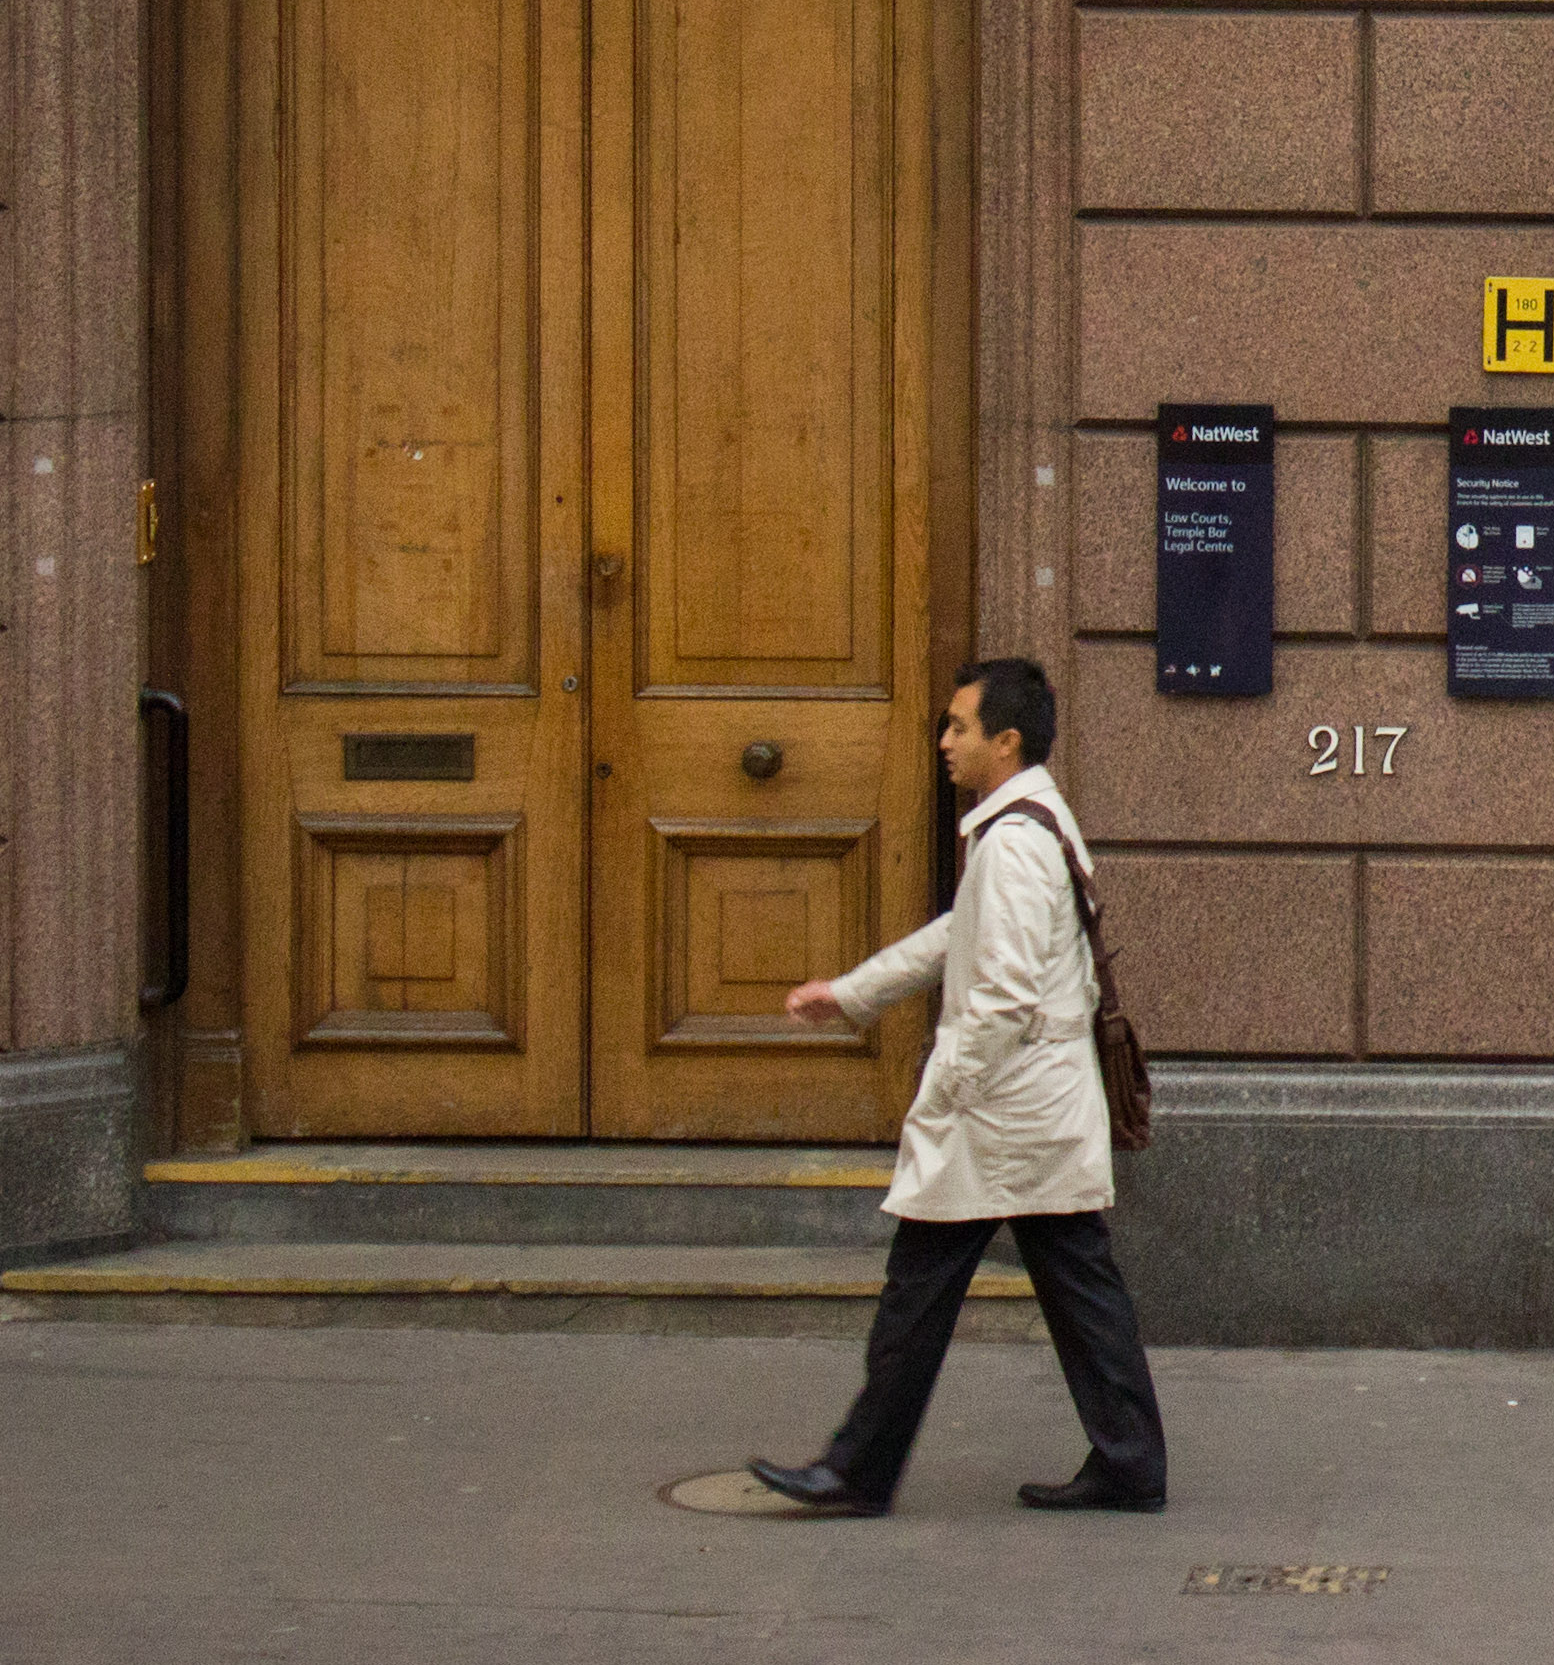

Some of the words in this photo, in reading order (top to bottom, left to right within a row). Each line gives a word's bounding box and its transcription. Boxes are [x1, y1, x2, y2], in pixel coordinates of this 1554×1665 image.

[1515, 297, 1539, 311] 180
[1192, 425, 1260, 443] NatWest
[1483, 428, 1551, 446] NatWest
[1165, 477, 1227, 492] Welcome
[1231, 479, 1246, 492] to
[1456, 477, 1490, 490] Security
[1492, 478, 1519, 488] Notice
[1164, 512, 1188, 523] Law
[1191, 512, 1233, 525] Courts,
[1165, 525, 1205, 539] Temple
[1208, 526, 1227, 538] Bar
[1164, 540, 1194, 554] Legal
[1196, 541, 1234, 553] Centre
[1307, 724, 1409, 776] 217
